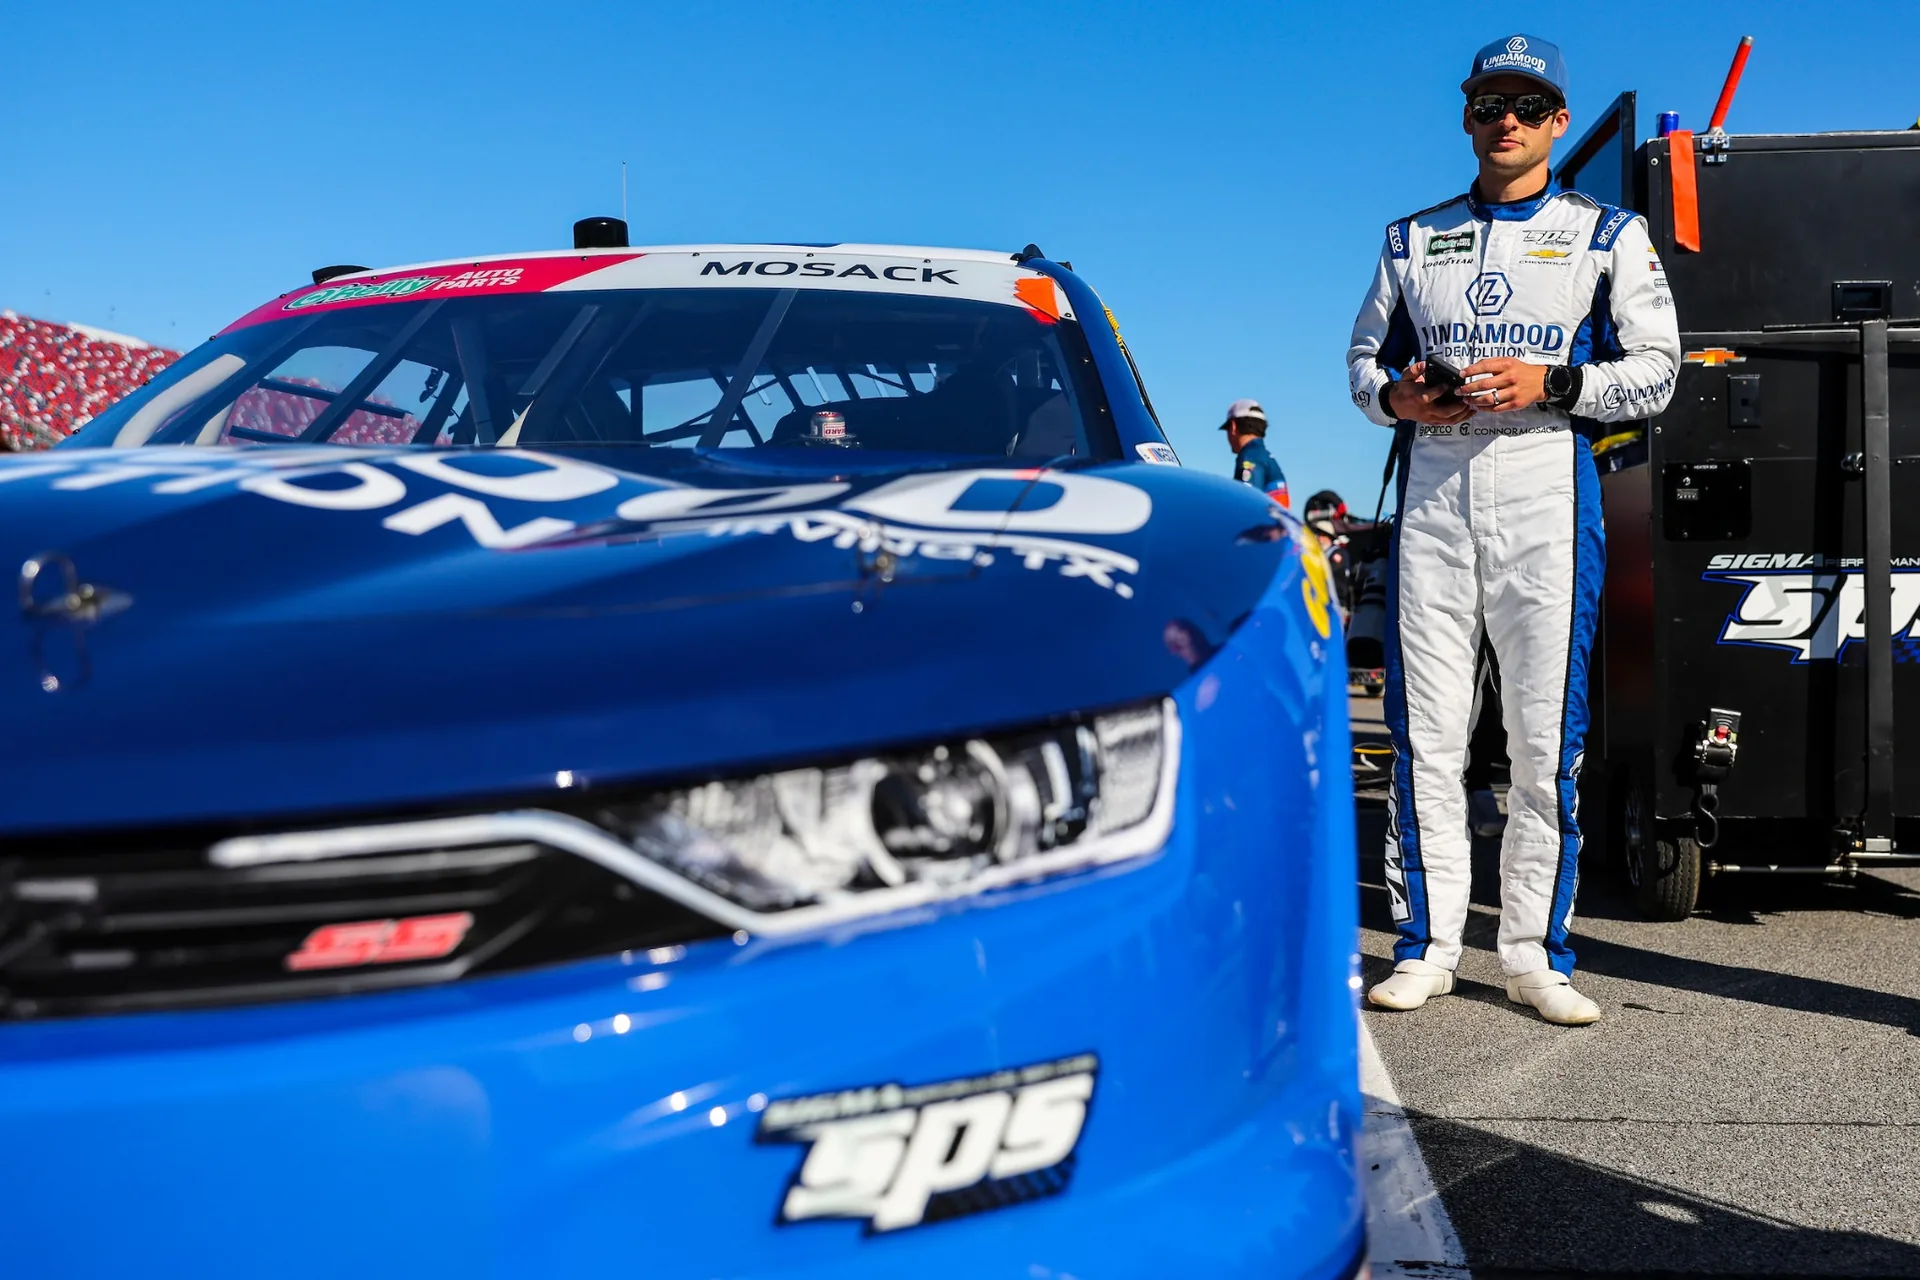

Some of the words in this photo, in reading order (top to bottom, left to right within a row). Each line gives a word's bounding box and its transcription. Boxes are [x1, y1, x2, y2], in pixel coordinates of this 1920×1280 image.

[1482, 53, 1546, 71] LINDAMOOD
[1494, 60, 1532, 69] DEMOLITION
[1597, 211, 1629, 246] sparco
[453, 268, 524, 280] AUTO
[700, 261, 960, 285] MOSACK
[433, 276, 521, 291] PARTS
[1421, 323, 1564, 352] LINDAMOOD
[1445, 346, 1526, 358] DEMOLITION
[1419, 425, 1452, 437] sparco
[1474, 427, 1518, 436] CONNOR
[1519, 425, 1559, 435] MOSACK
[1706, 553, 1823, 569] SIGMA
